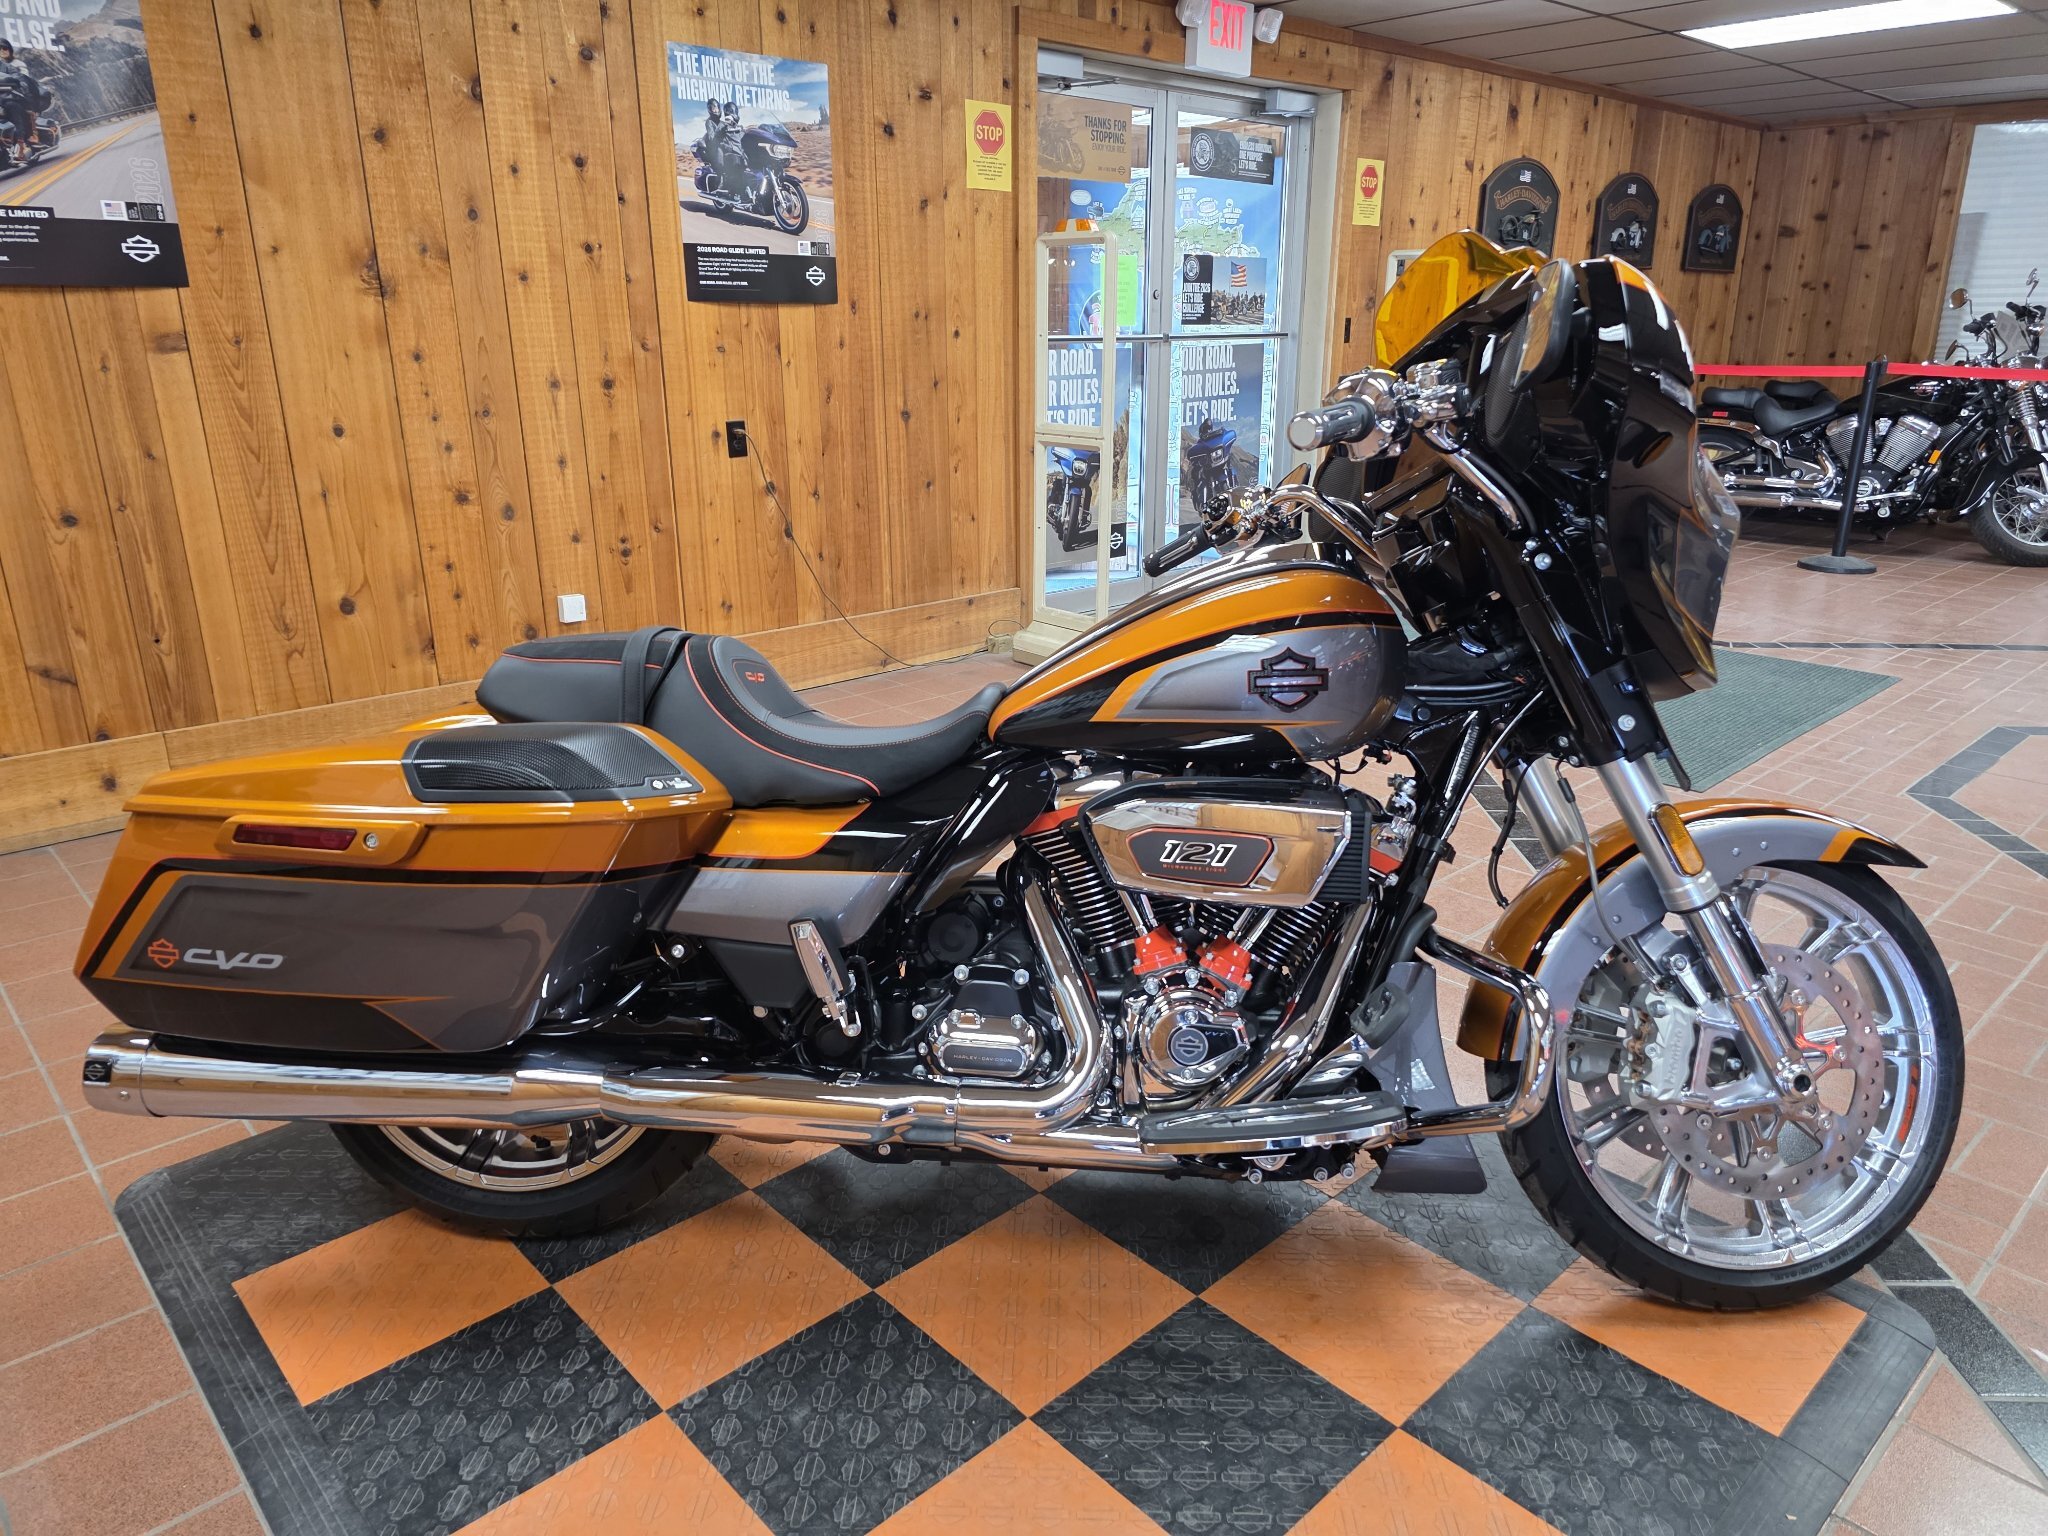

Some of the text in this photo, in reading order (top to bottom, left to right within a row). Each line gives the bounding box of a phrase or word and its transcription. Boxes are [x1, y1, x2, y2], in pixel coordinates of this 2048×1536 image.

[3, 17, 66, 53] ELSE.
[1209, 0, 1247, 52] EXIT
[674, 51, 775, 87] THE KING OF THE
[676, 77, 794, 112] HIGHWAY RETURNS.
[976, 124, 1003, 142] STOP
[1084, 115, 1127, 132] THANKS FOR
[1090, 129, 1127, 145] STOPPING.
[1361, 176, 1378, 189] STOP
[7, 209, 49, 219] LIMITED
[728, 247, 744, 255] GLIDE
[1060, 348, 1097, 376] ROAD.
[1182, 344, 1236, 372] OUR ROAD.
[1060, 378, 1103, 406] RULES.
[1182, 370, 1240, 400] OUR RULES.
[1181, 397, 1237, 426] LET'S RIDE.
[1159, 839, 1238, 867] 121
[183, 948, 284, 970] CVO
[953, 1053, 1014, 1064] HARLEY-DAVIDSON
